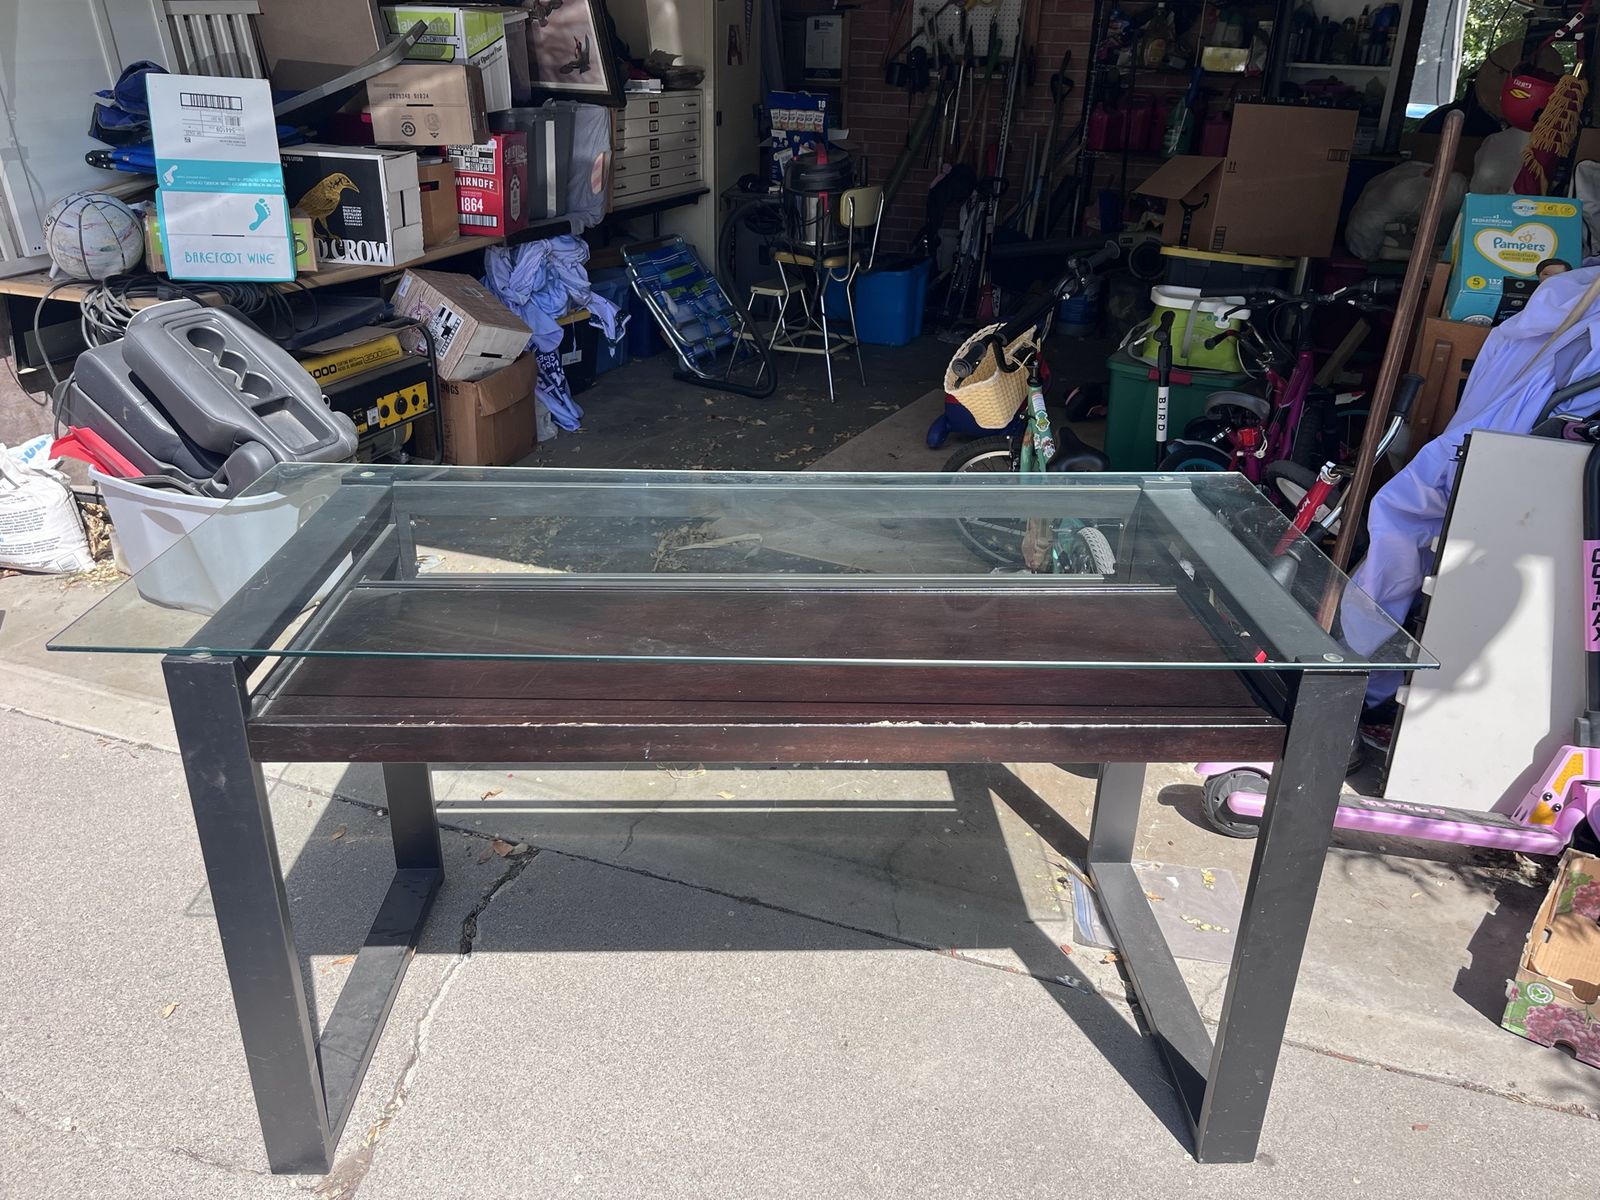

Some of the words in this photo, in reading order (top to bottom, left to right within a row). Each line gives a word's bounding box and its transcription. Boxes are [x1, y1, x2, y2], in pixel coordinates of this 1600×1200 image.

[461, 196, 484, 213] 1864
[331, 238, 389, 263] CROW
[1493, 236, 1546, 252] Pampers
[184, 251, 243, 264] BAREFOOT
[247, 252, 276, 264] WINE
[1471, 278, 1481, 286] 5
[308, 364, 338, 379] 000
[1158, 396, 1167, 431] BIRD
